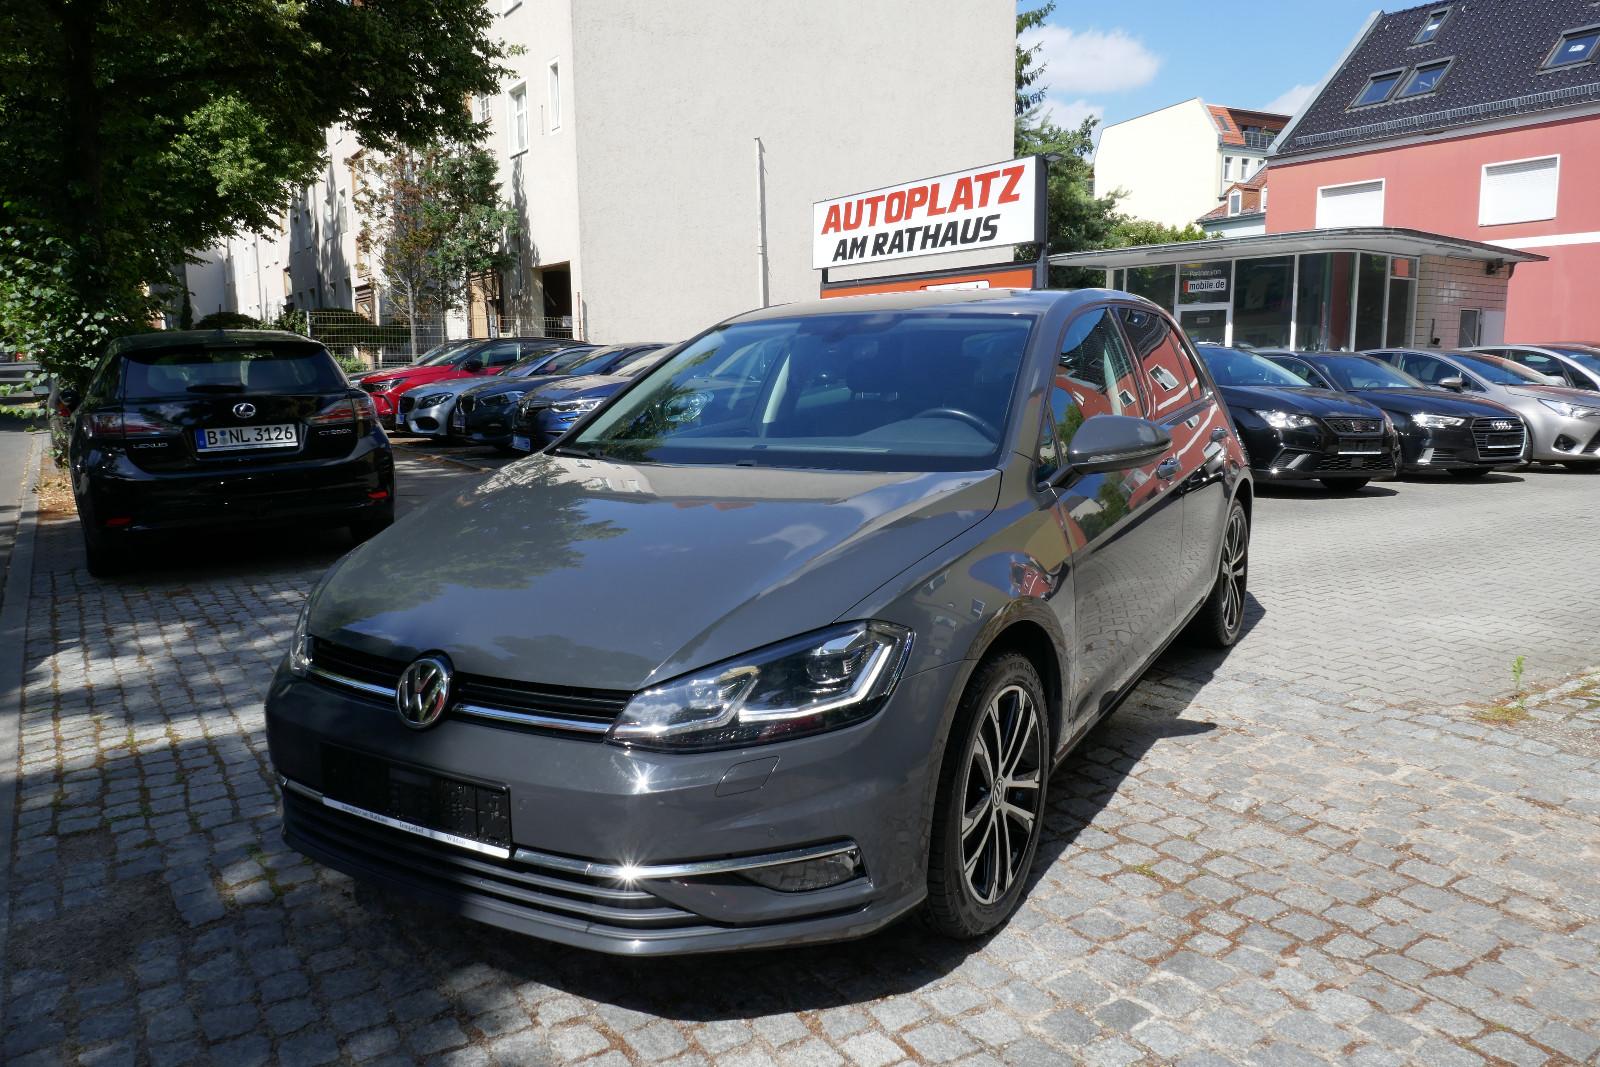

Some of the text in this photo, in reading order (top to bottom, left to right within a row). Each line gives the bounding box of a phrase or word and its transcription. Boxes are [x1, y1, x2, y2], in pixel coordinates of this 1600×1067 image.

[821, 164, 1025, 235] AUTOPLATZ
[832, 214, 1001, 262] AM RATHAUS
[1189, 280, 1225, 290] mobile.de
[207, 427, 293, 445] B NL 3126
